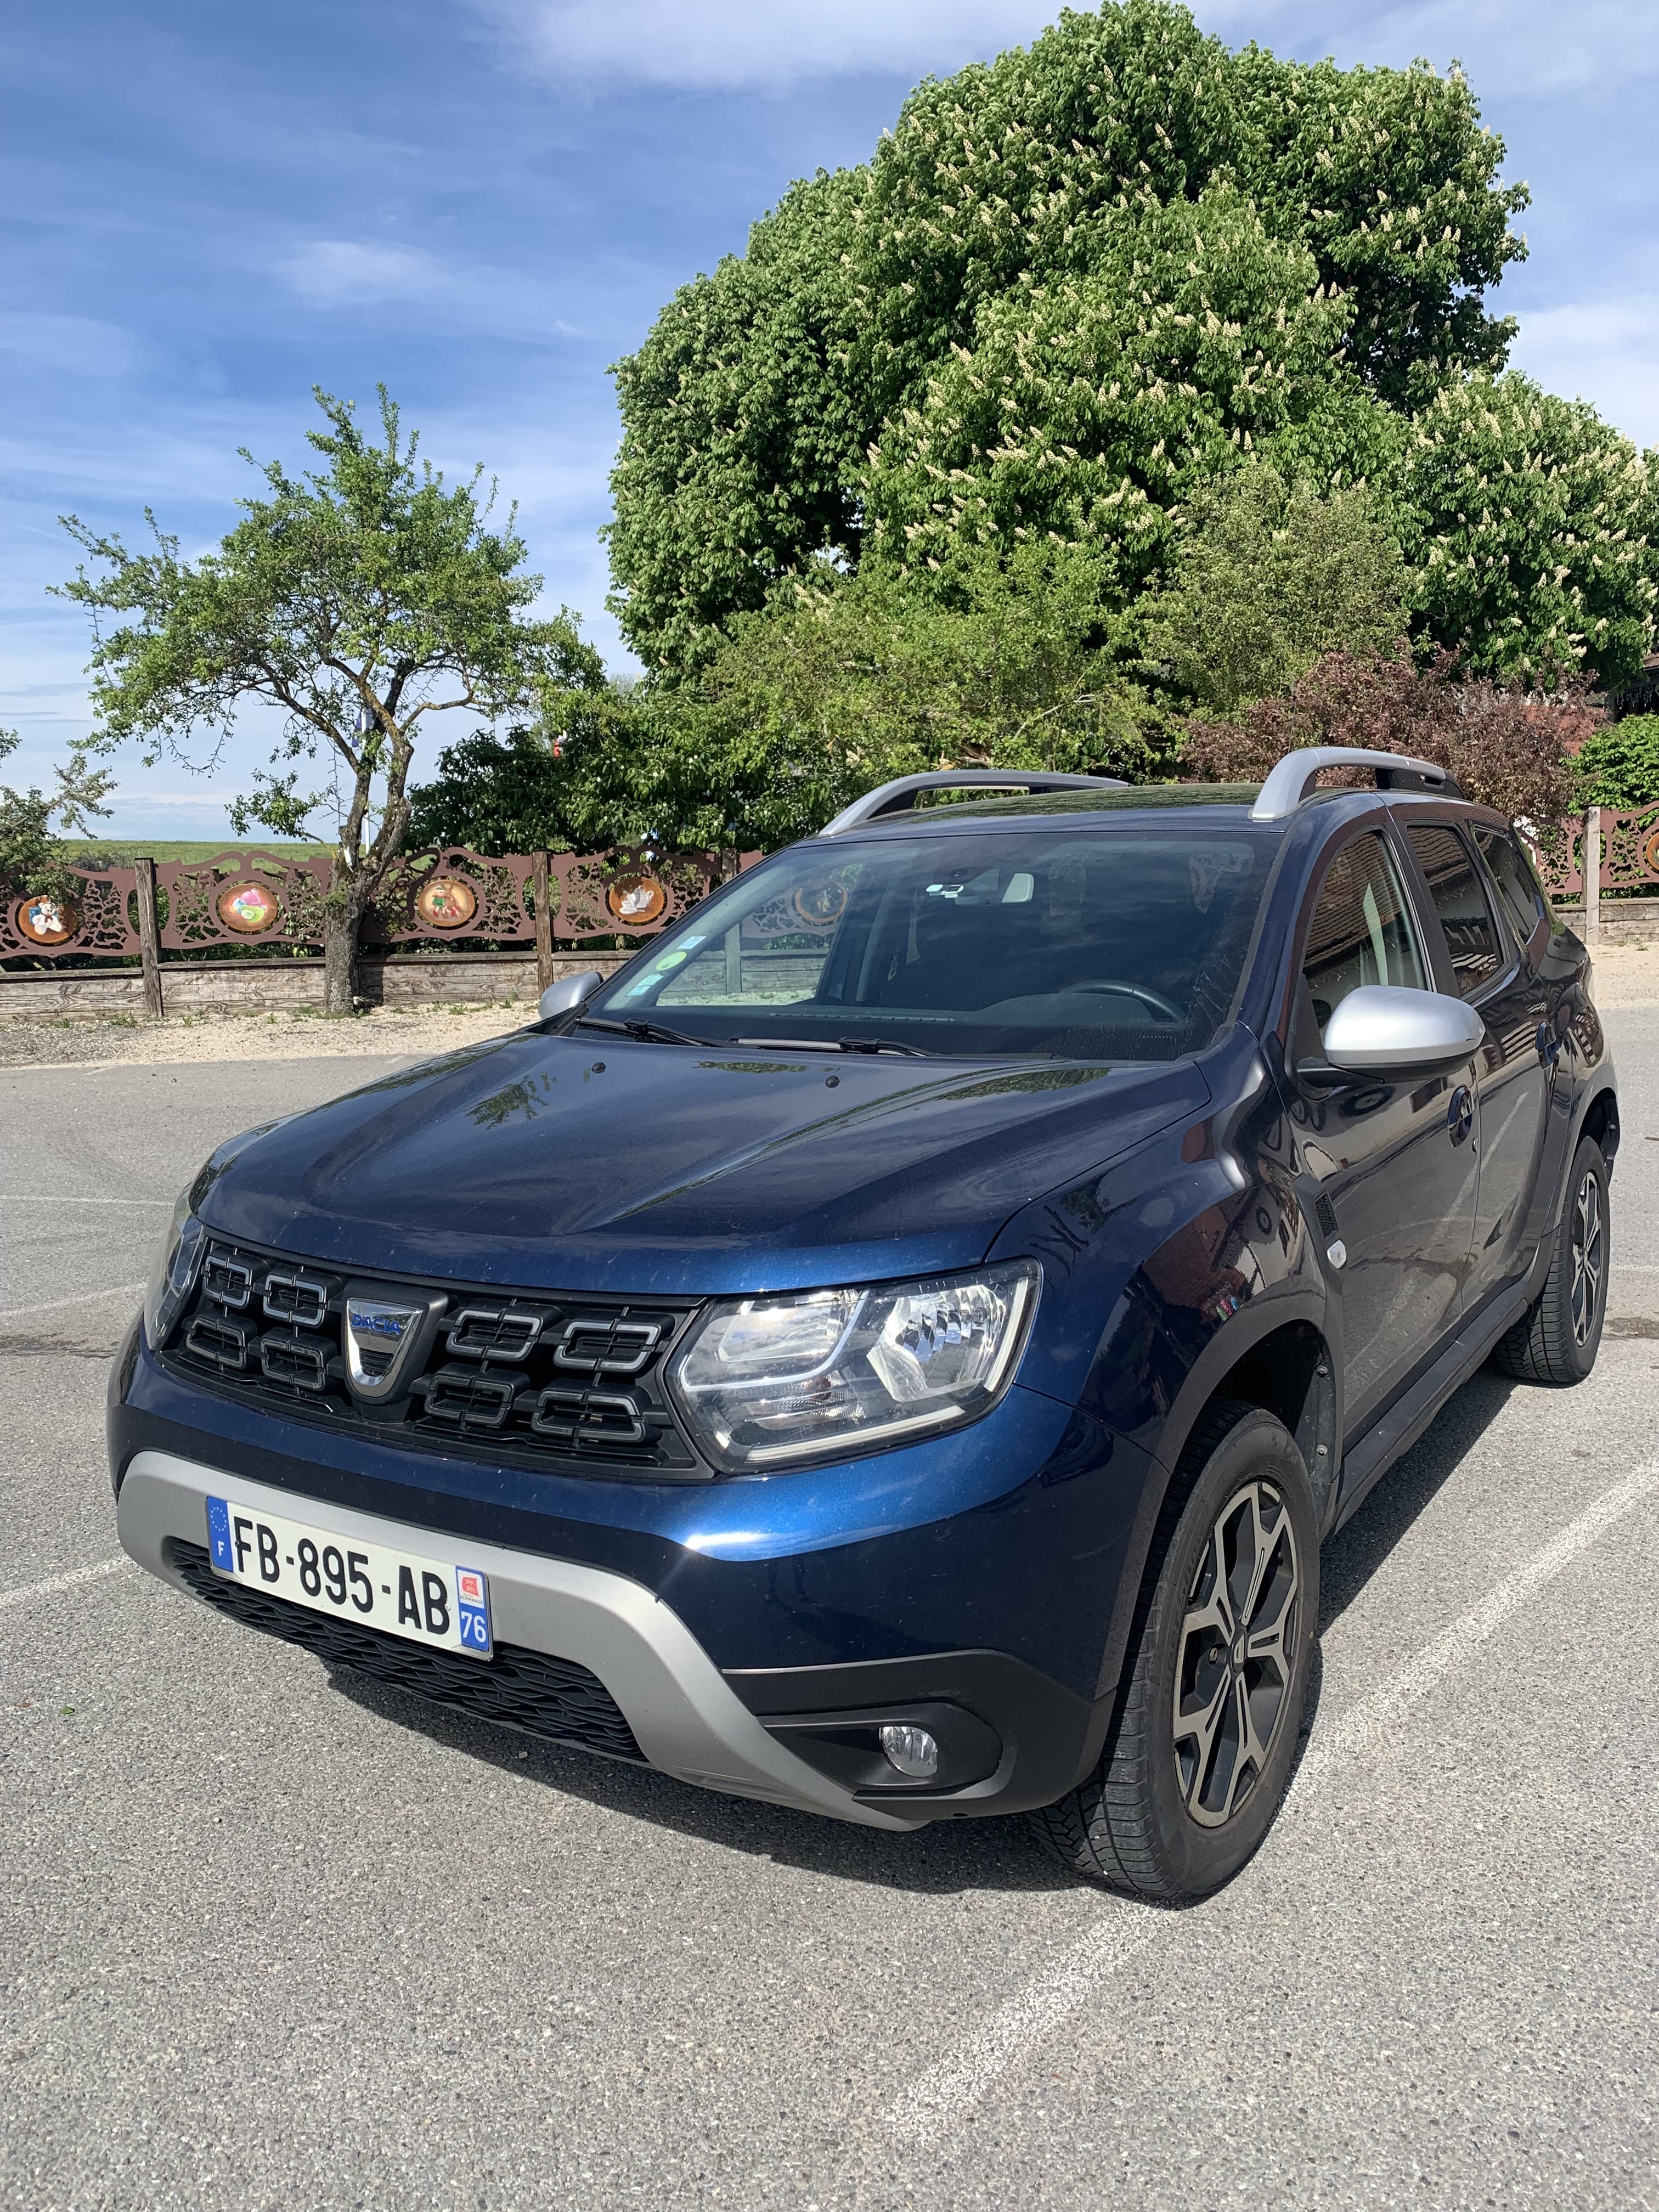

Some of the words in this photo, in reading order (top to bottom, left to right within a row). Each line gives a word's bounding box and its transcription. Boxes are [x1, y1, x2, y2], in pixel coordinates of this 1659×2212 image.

[352, 1314, 401, 1335] DACIA
[218, 1541, 224, 1556] F
[234, 1516, 450, 1635] FB-895-AB
[461, 1611, 486, 1643] 76
